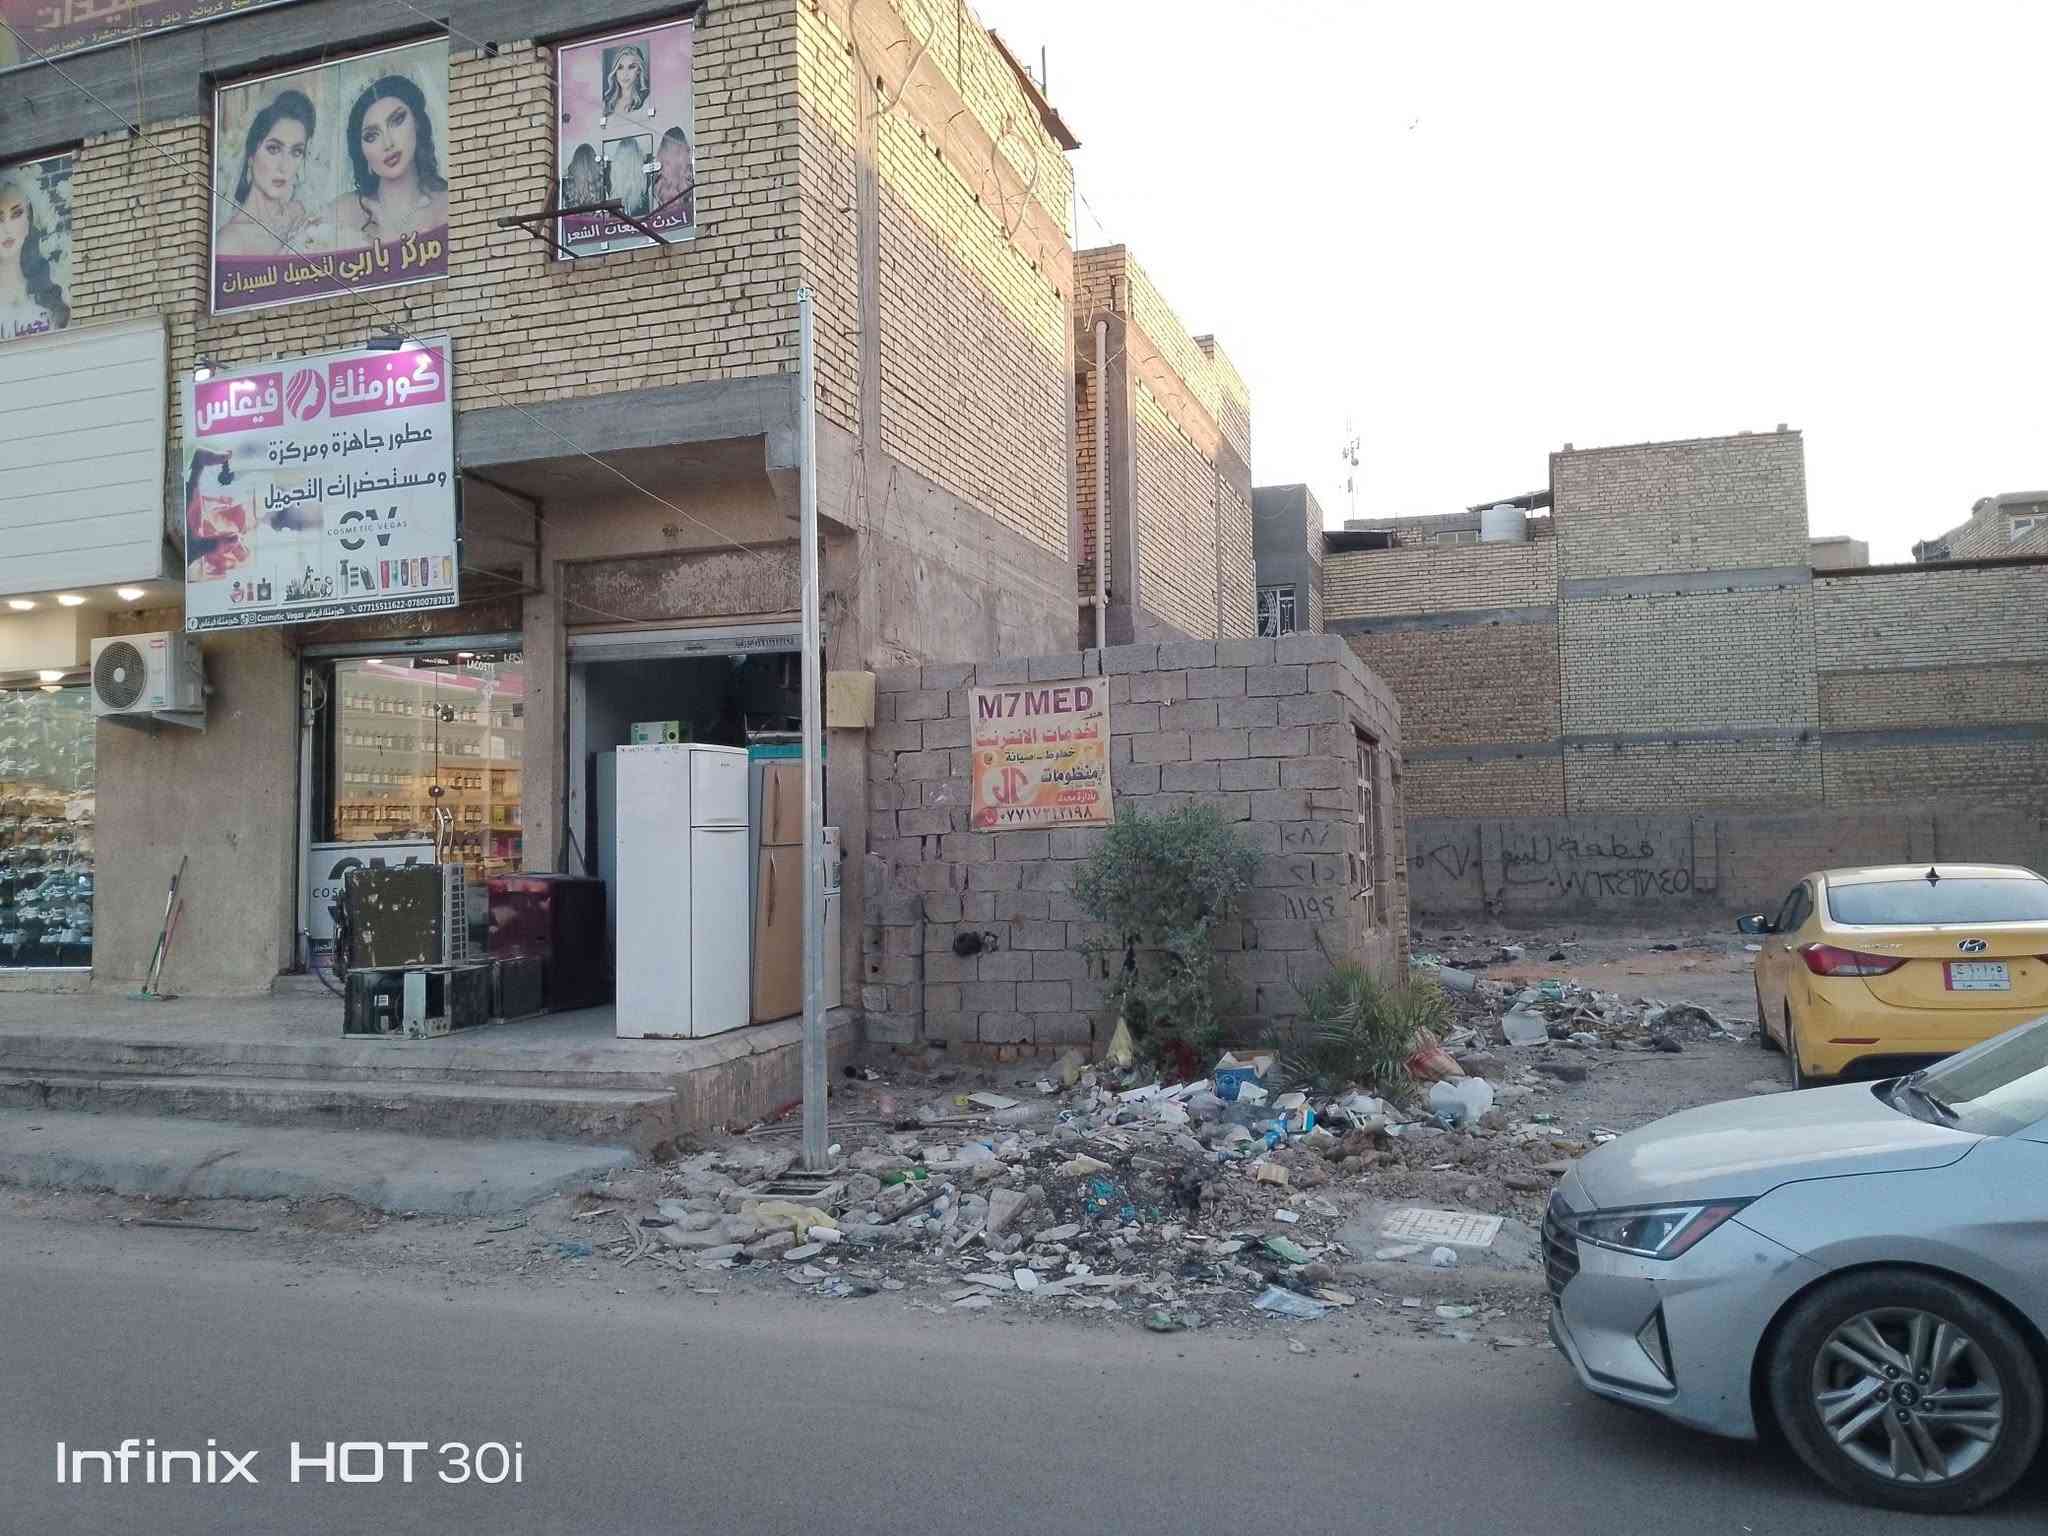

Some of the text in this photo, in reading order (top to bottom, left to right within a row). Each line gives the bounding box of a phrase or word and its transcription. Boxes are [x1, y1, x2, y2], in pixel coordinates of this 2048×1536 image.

[567, 224, 600, 243] الشعر
[652, 211, 688, 229] احدث
[400, 232, 442, 269] مركز
[222, 265, 278, 293] للسيدات
[331, 352, 440, 406] كوزمتك
[268, 423, 433, 465] عطور جاهزة ومركزة
[264, 467, 447, 511] ومستحضرات التجميل
[327, 521, 407, 536] COSMETIC VEGAS
[978, 687, 1094, 718] M7MED
[1558, 834, 1654, 860] قطعة
